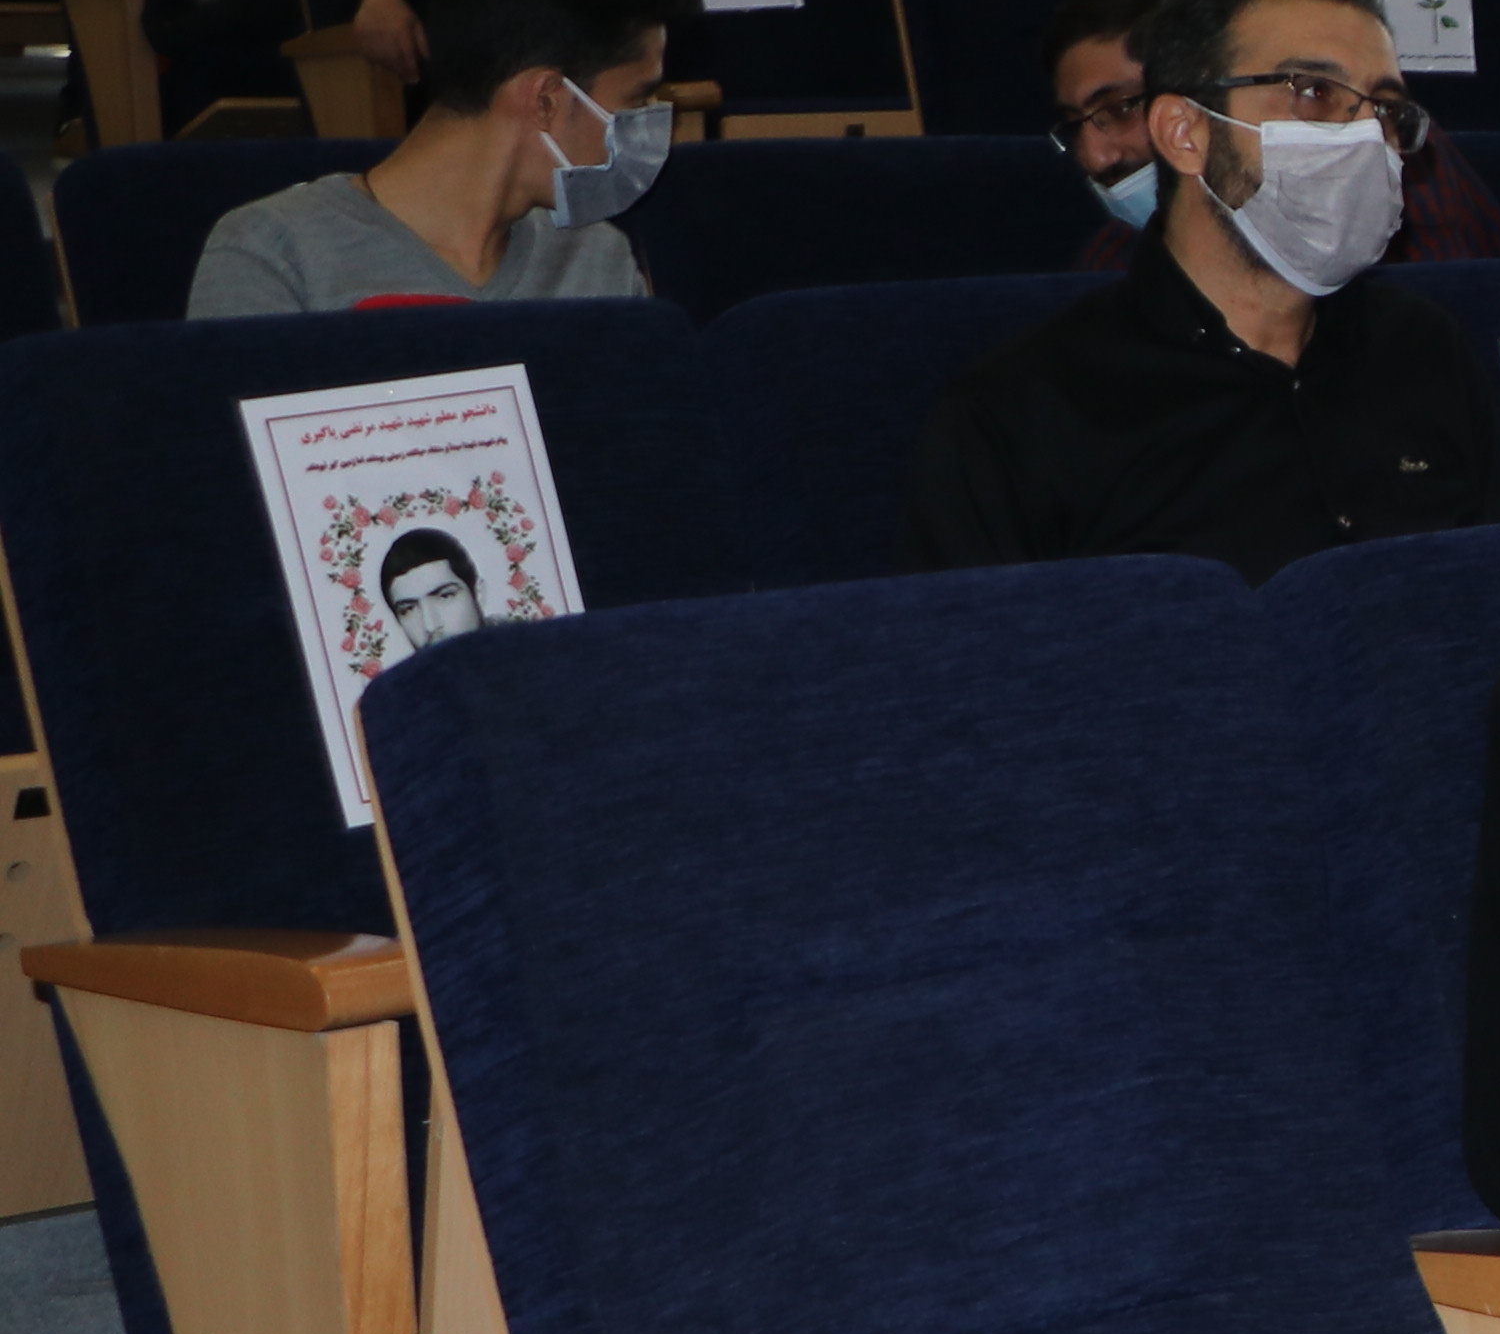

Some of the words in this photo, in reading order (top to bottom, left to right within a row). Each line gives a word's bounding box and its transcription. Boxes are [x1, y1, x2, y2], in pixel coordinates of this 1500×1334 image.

[407, 412, 432, 427] شهید
[435, 409, 457, 425] معلم
[461, 403, 497, 422] دانشجو
[340, 421, 375, 440] مرتضی
[379, 416, 404, 431] شهید
